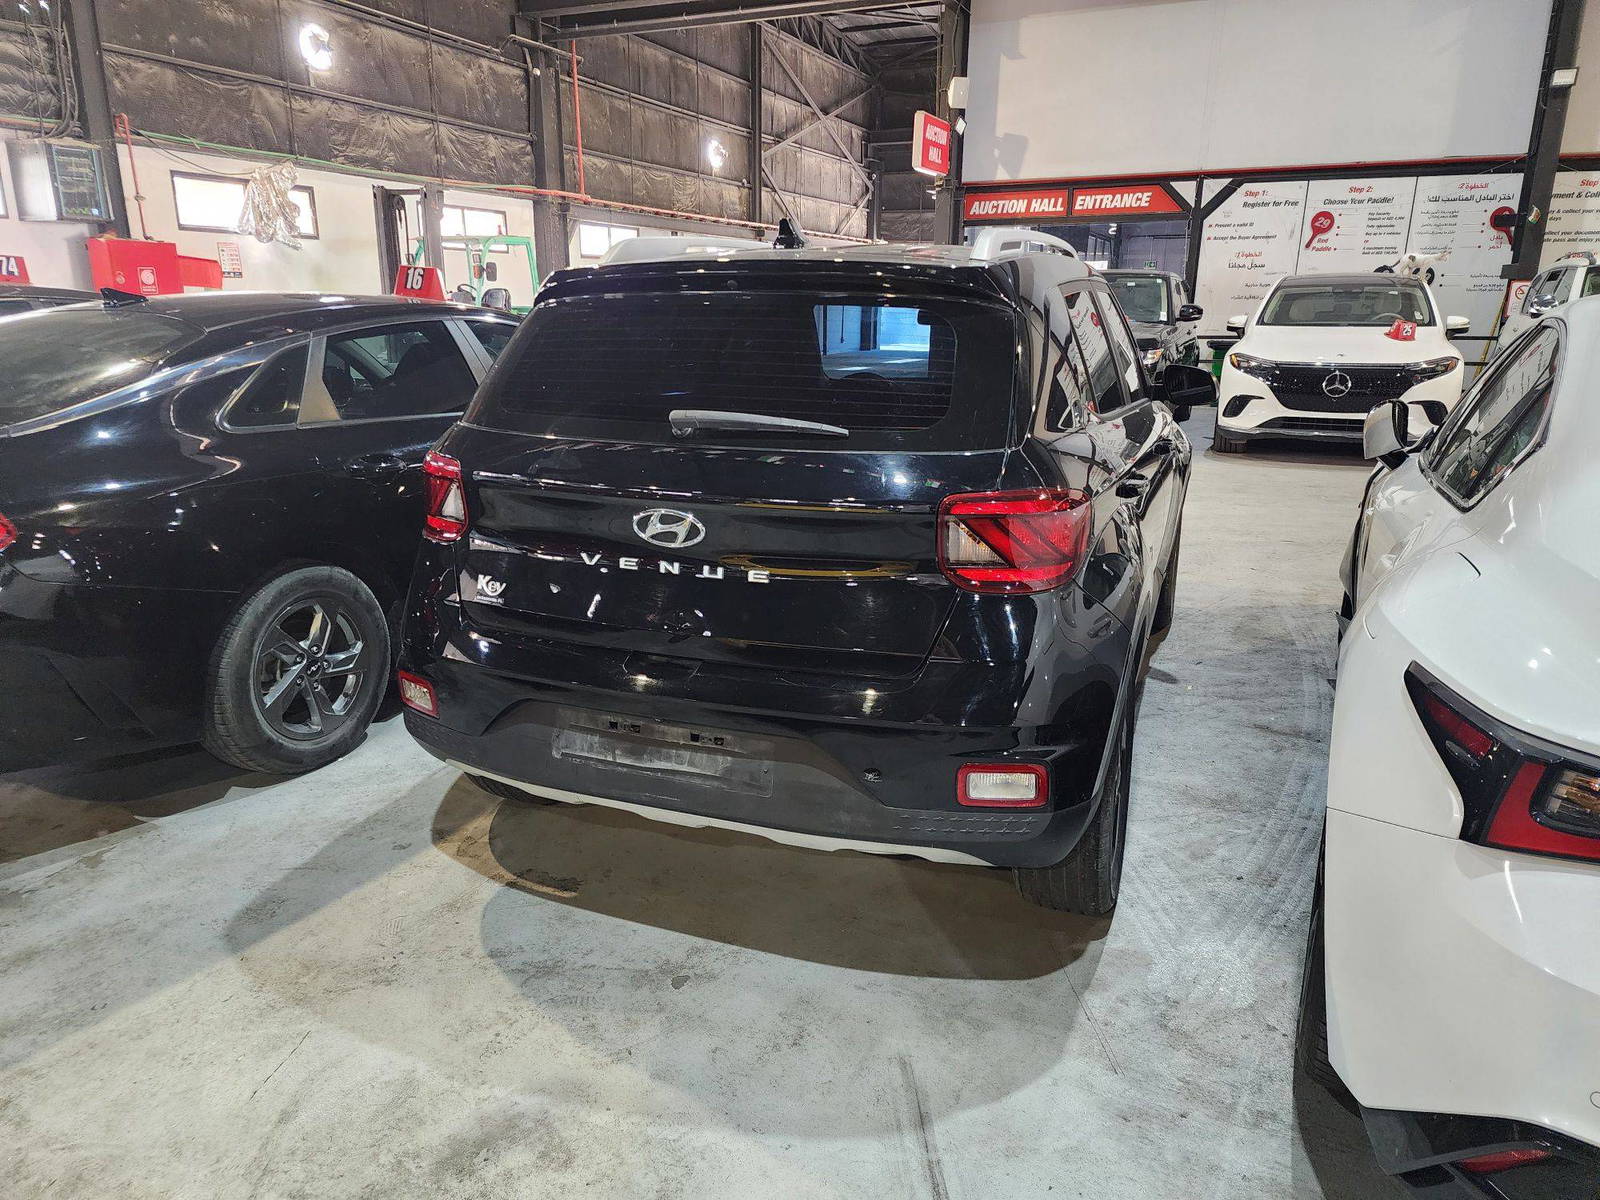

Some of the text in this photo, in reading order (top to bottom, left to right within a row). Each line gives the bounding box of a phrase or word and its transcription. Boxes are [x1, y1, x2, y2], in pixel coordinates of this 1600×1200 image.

[926, 123, 948, 145] AUCTION
[928, 146, 942, 164] HALL
[1244, 190, 1260, 198] Step
[1348, 185, 1374, 194] Step 2:
[970, 197, 1064, 215] AUCTION HALL
[1074, 192, 1152, 211] ENTRANCE
[1242, 201, 1270, 209] Register
[1323, 198, 1348, 206] Choose
[1367, 196, 1394, 204] Paddle!
[1313, 216, 1331, 229] 29
[406, 267, 424, 290] 16
[1402, 323, 1413, 336] 25
[580, 551, 770, 584] VENUE
[477, 574, 507, 596] Key
